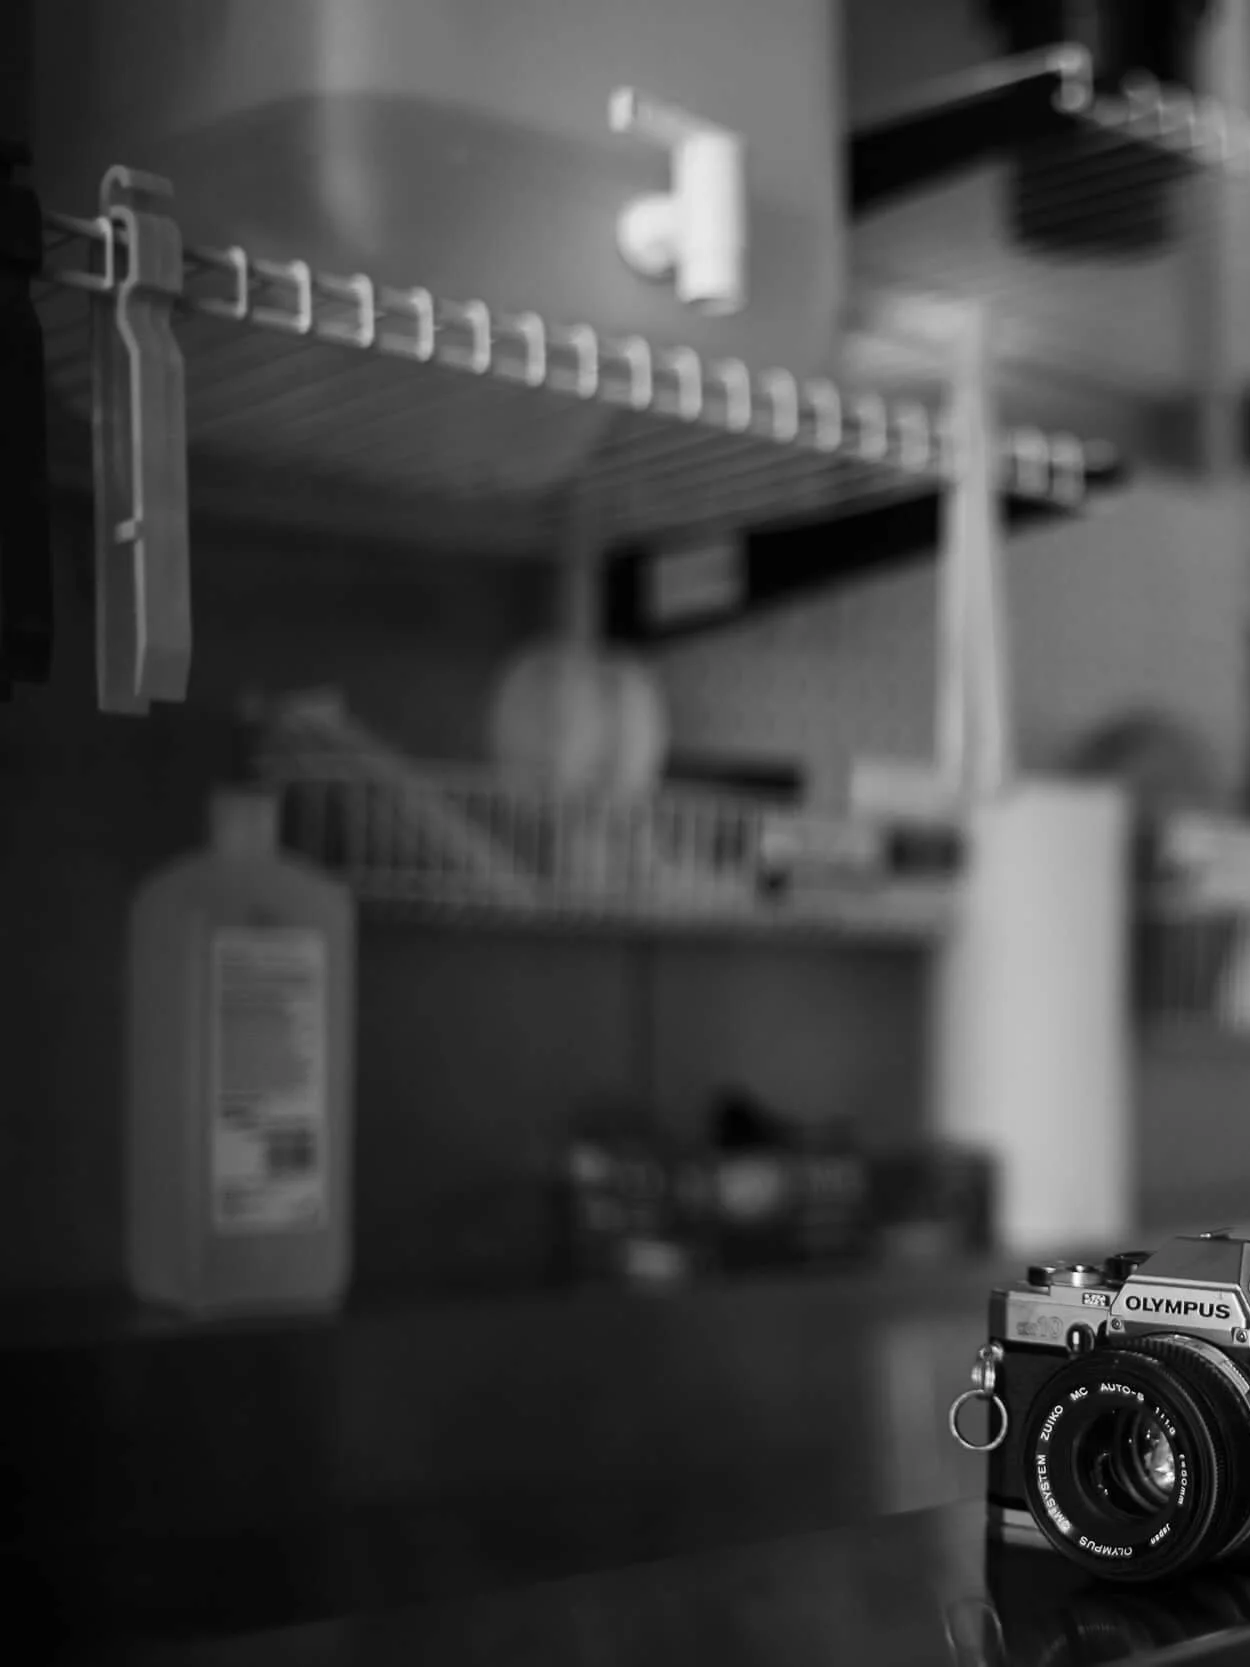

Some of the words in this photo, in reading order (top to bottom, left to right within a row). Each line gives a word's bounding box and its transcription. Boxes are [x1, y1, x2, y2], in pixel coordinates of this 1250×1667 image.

[1125, 1295, 1231, 1320] OLYMPUS
[1069, 1386, 1089, 1401] MC
[1040, 1404, 1064, 1441] ZUIKO
[1079, 1535, 1134, 1556] OLYMPUS
